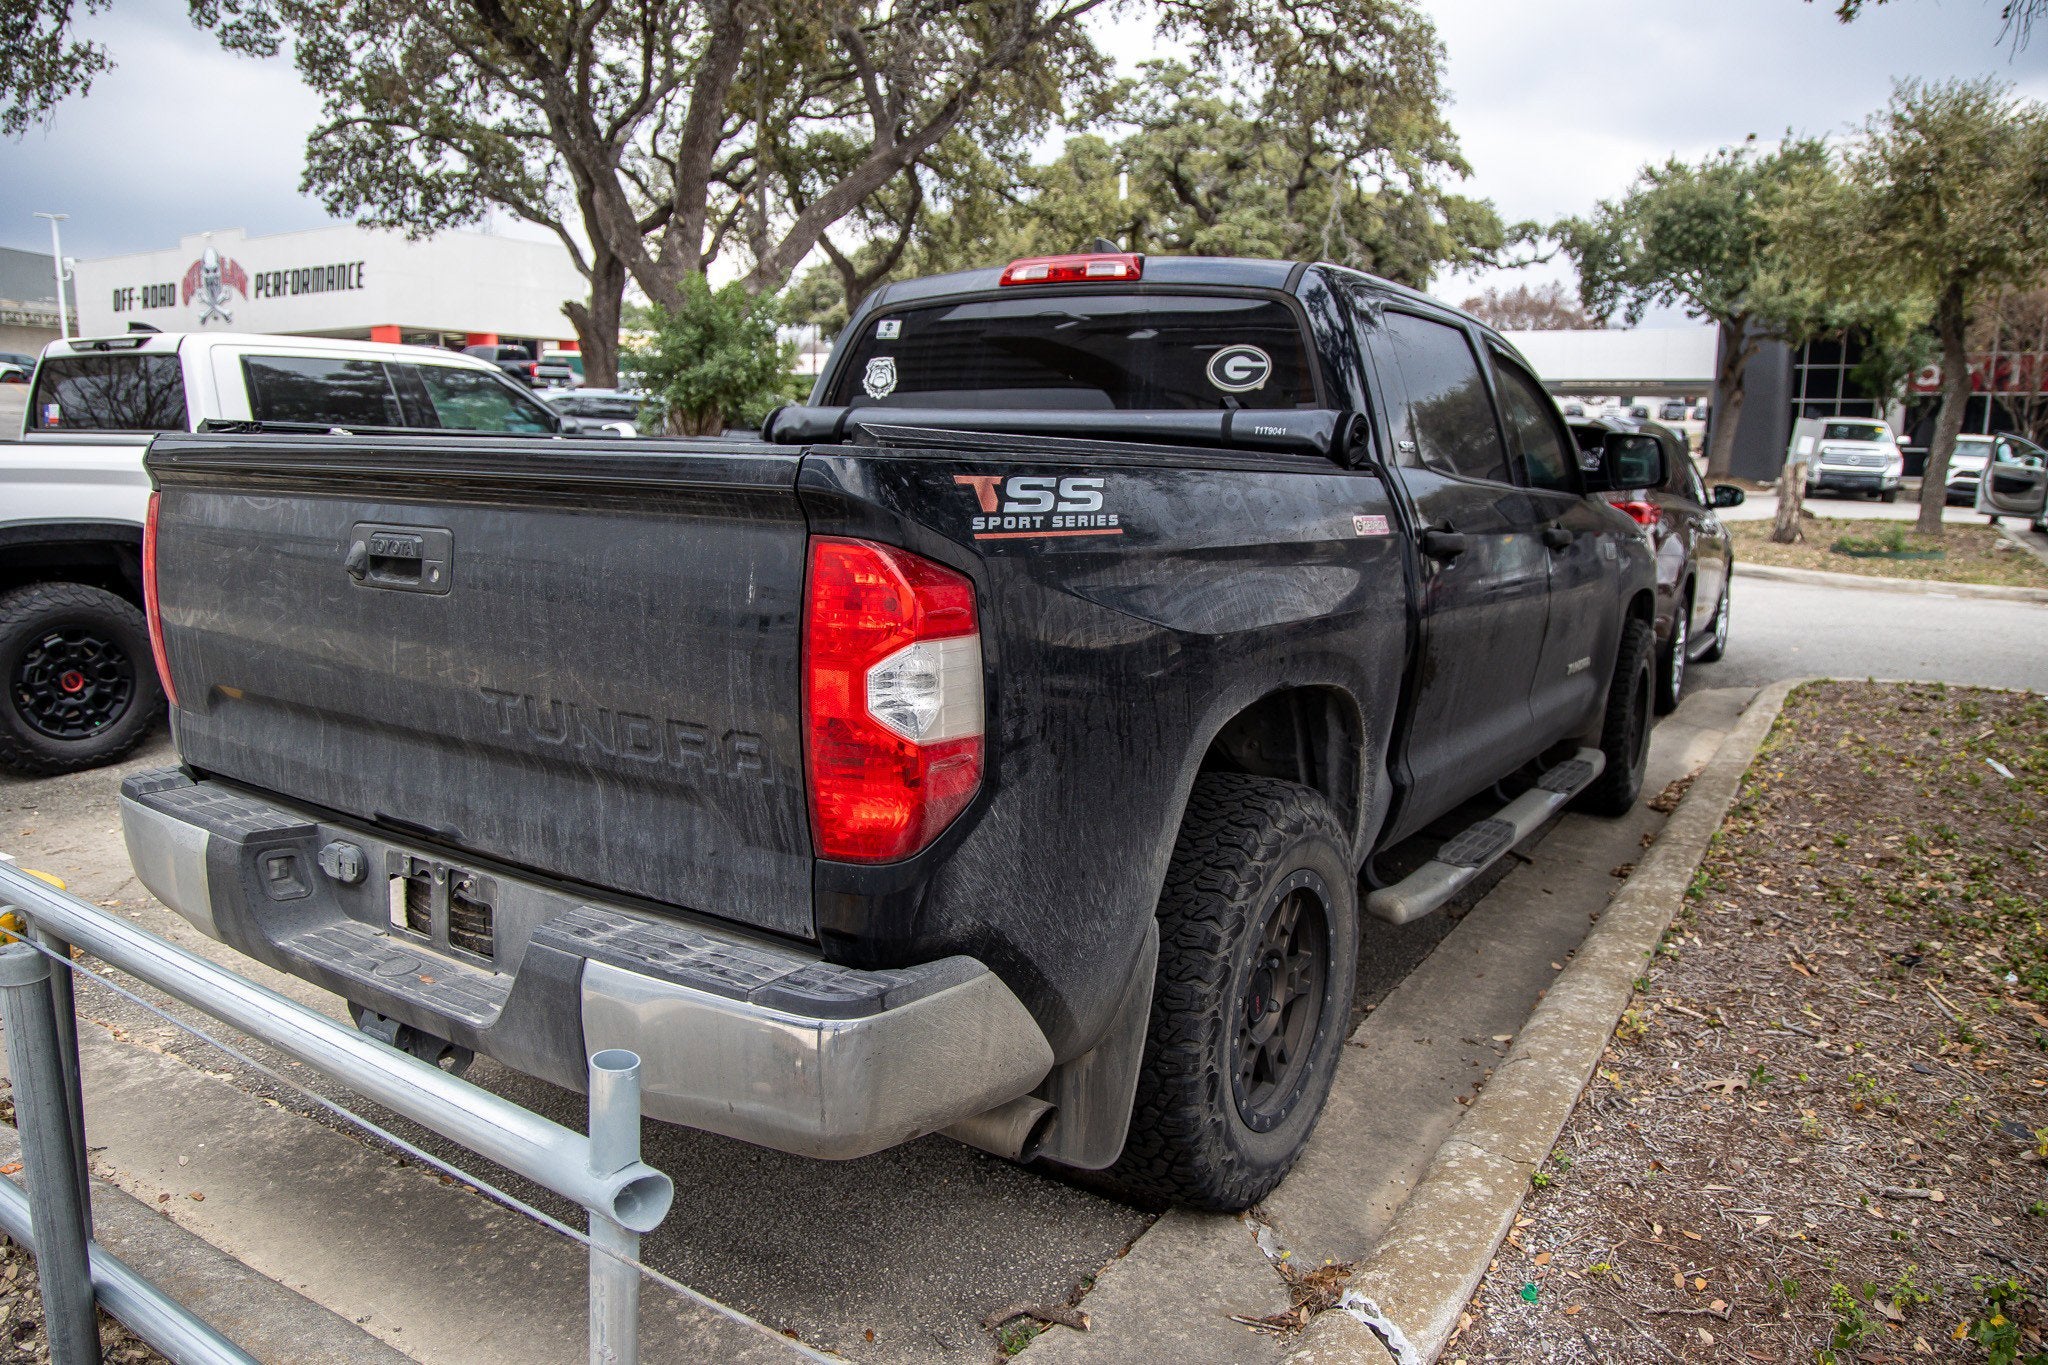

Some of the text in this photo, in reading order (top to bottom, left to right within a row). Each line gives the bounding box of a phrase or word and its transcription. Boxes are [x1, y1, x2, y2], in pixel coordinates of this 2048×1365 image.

[113, 283, 176, 312] OFF-ROAD
[255, 261, 365, 298] PERFORMANCE
[1254, 426, 1287, 435] T1T9041
[953, 475, 1105, 512] TSS
[972, 514, 1119, 530] SPORT SERIES
[370, 538, 414, 557] TOYOTA
[480, 686, 774, 785] TUNDRA
